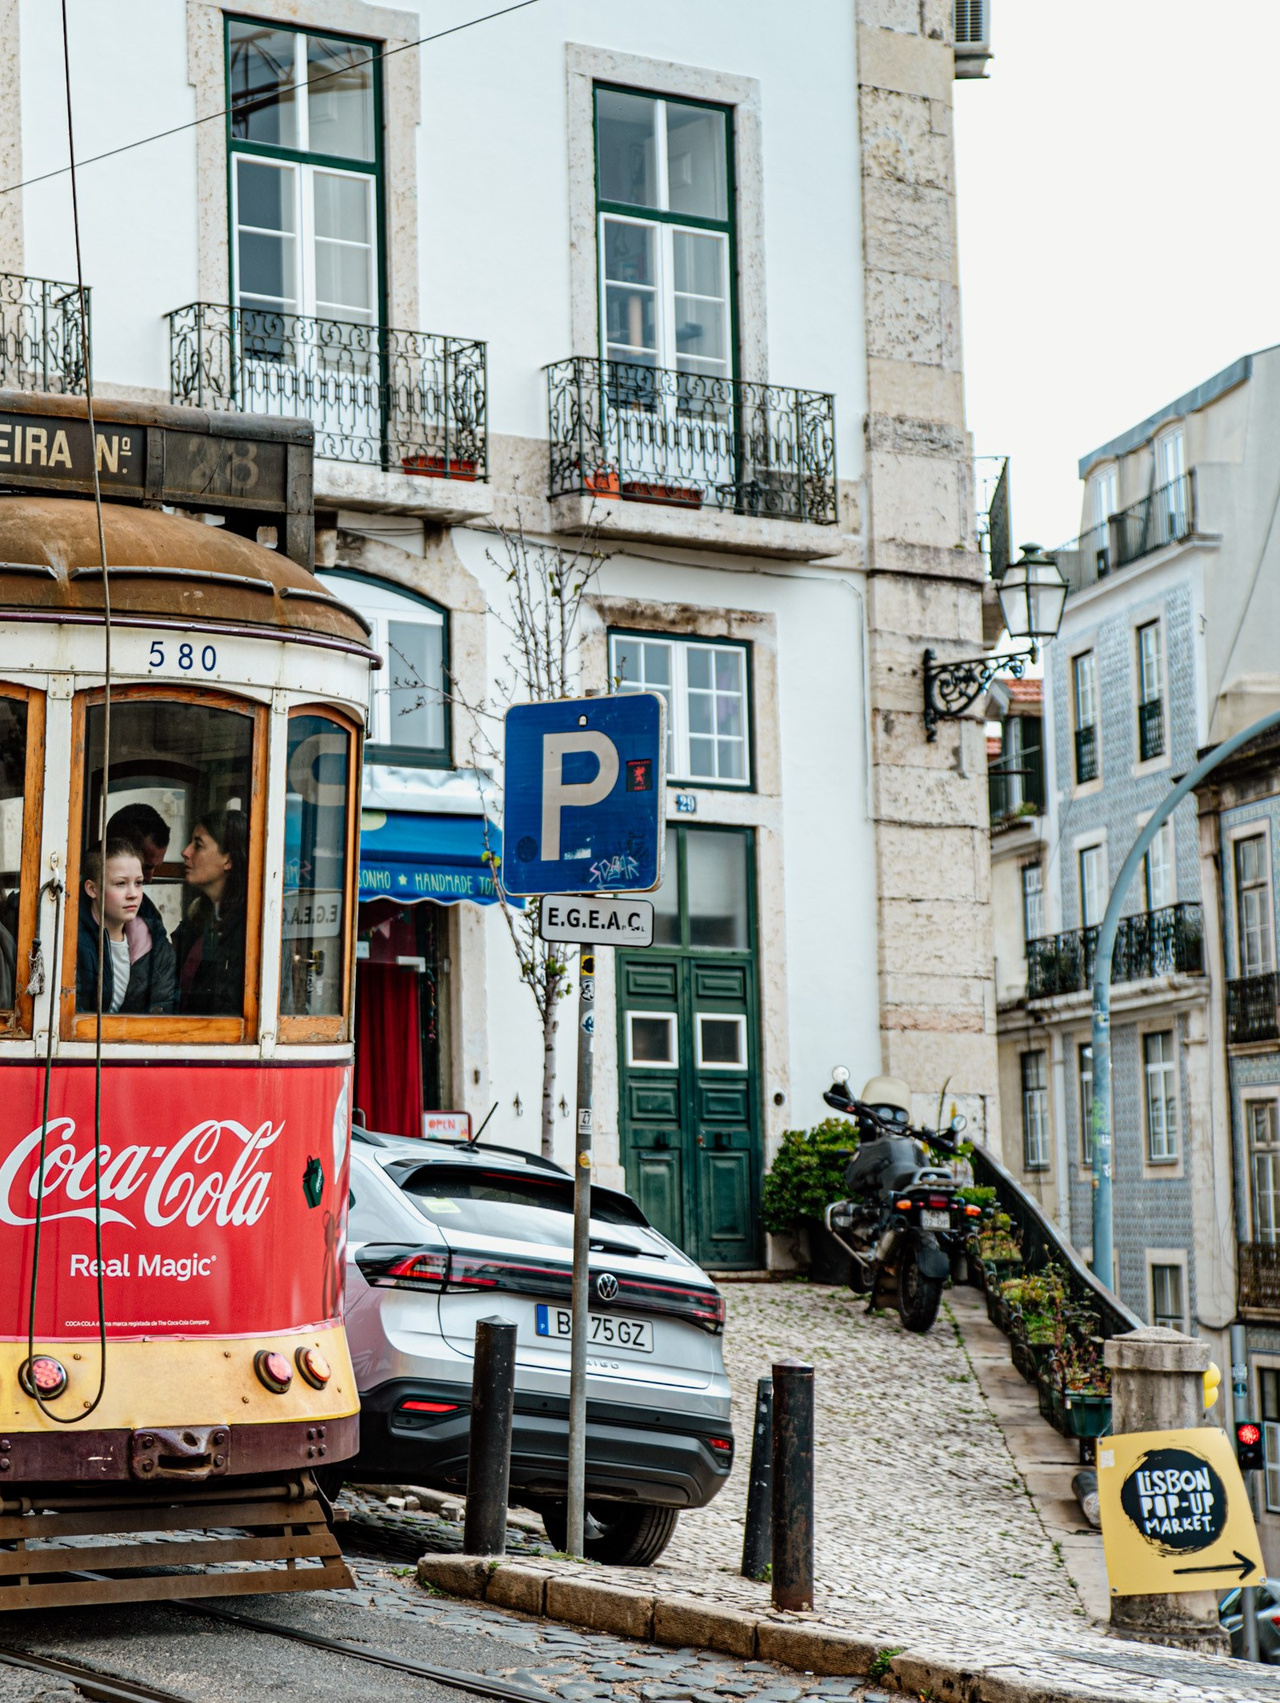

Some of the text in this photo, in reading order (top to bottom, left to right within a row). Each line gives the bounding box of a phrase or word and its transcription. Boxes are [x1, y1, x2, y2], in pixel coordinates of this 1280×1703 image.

[188, 438, 259, 490] 28
[541, 730, 620, 862] P
[415, 872, 474, 895] HANDMADE
[428, 1119, 455, 1131] OPEN
[70, 1253, 131, 1277] Real
[557, 1311, 571, 1335] B
[1140, 1491, 1215, 1519] POP-UP
